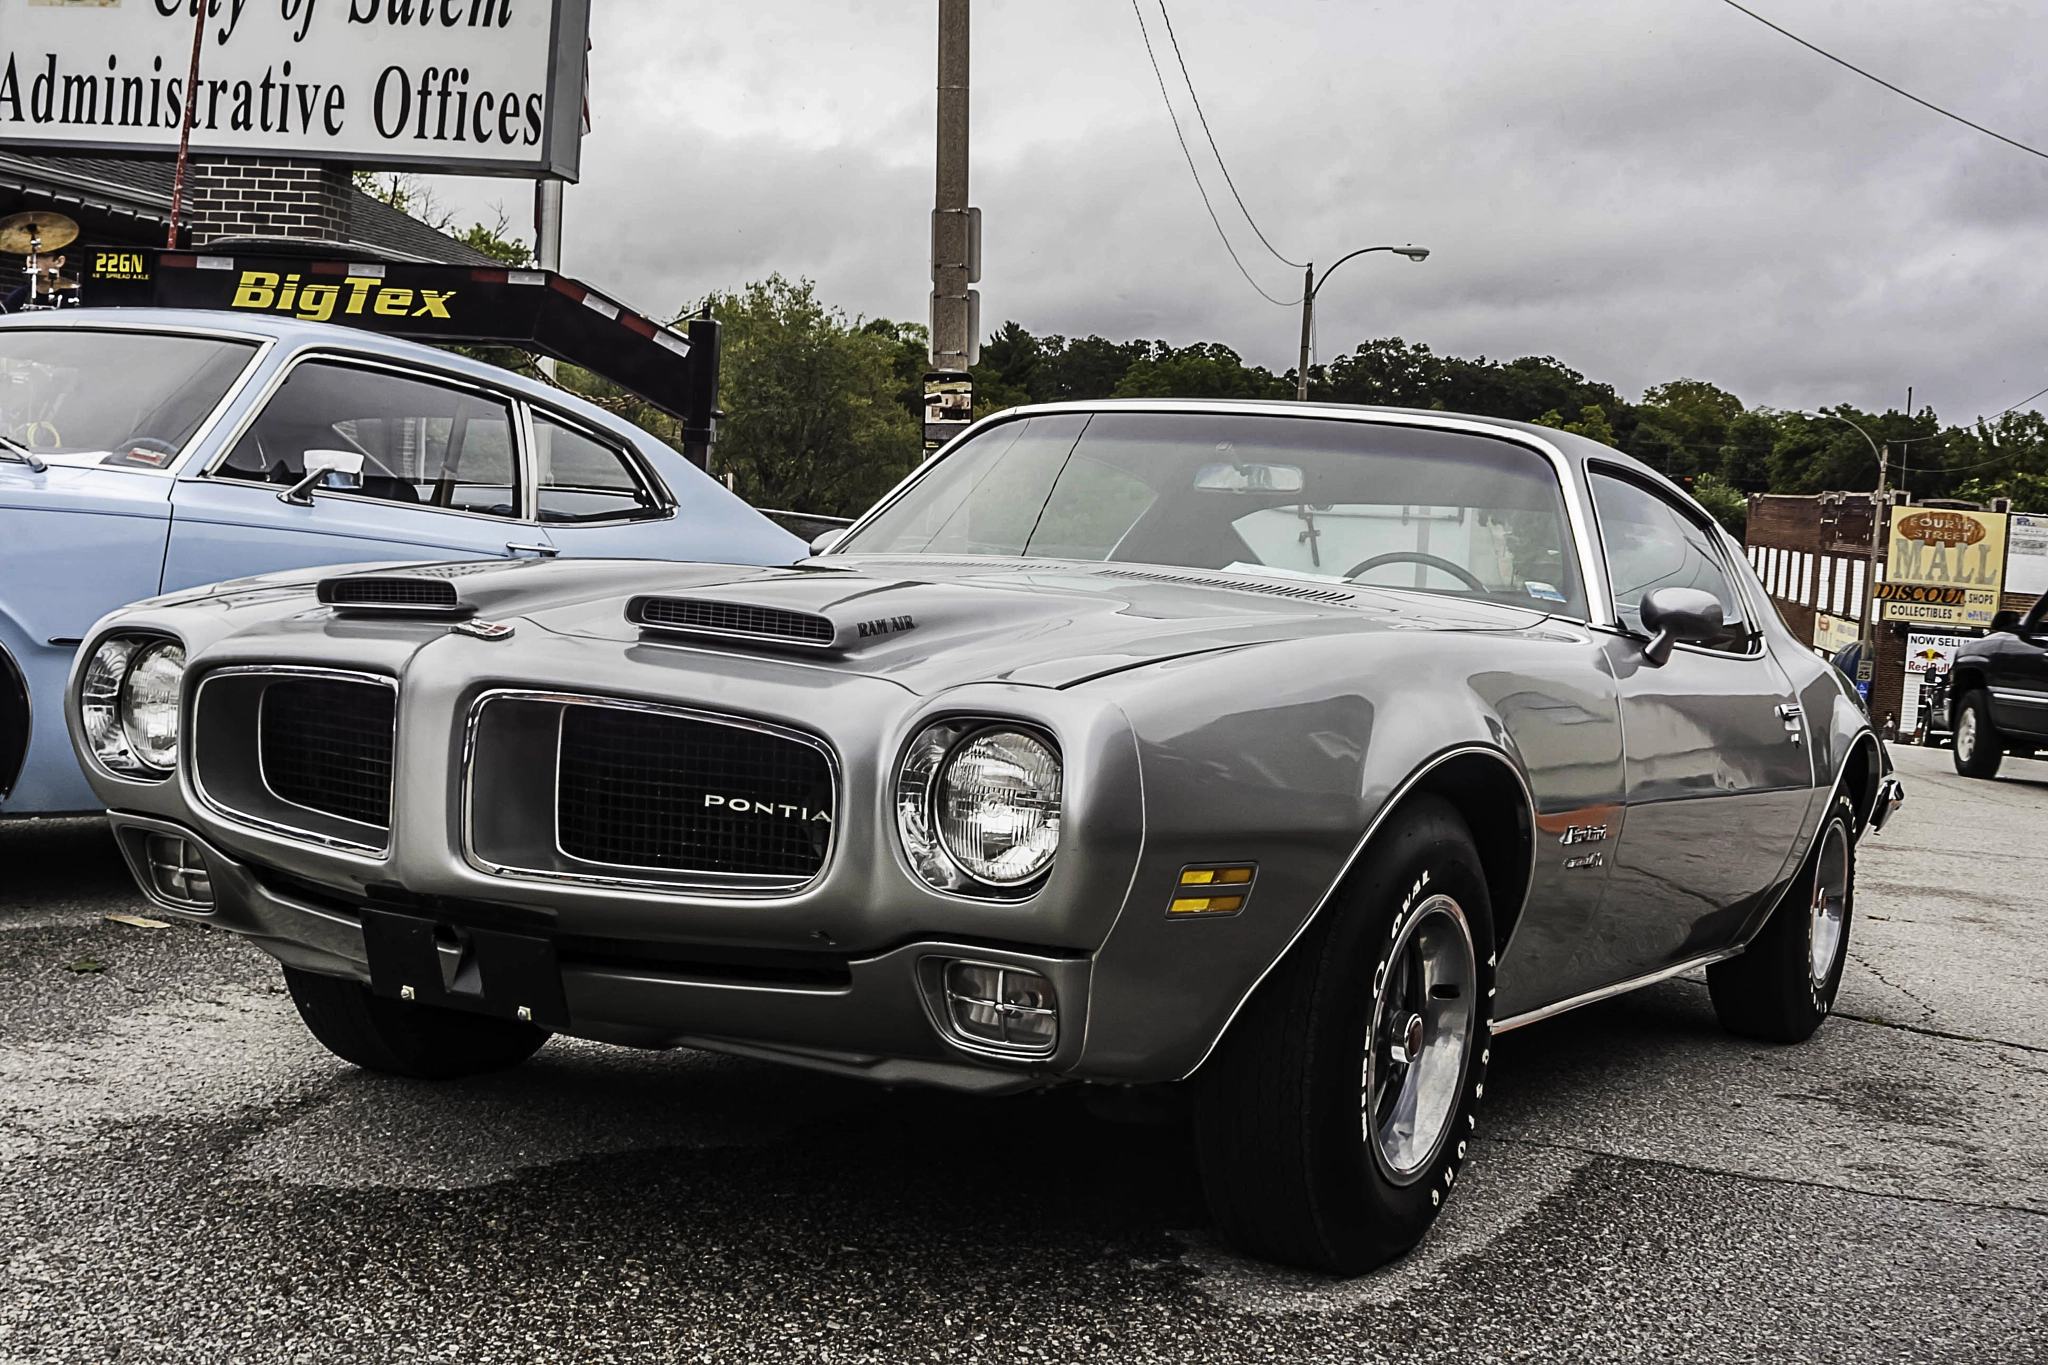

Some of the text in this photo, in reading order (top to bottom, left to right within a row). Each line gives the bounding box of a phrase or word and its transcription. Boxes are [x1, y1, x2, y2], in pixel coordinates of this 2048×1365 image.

[373, 66, 542, 146] Offices
[96, 253, 143, 273] 22GN
[231, 271, 457, 321] BigTex
[1910, 517, 1975, 531] FOURTH
[1914, 529, 1971, 542] STREET
[1893, 538, 1997, 585] MALL
[1968, 593, 1994, 605] SHOPS
[1890, 605, 1952, 619] COLLECTIBLES
[857, 615, 916, 638] RAM AIR
[1910, 635, 1936, 646] NOW
[1908, 660, 1929, 672] Red
[1858, 671, 1870, 680] 25
[1391, 870, 1430, 939] OVAL
